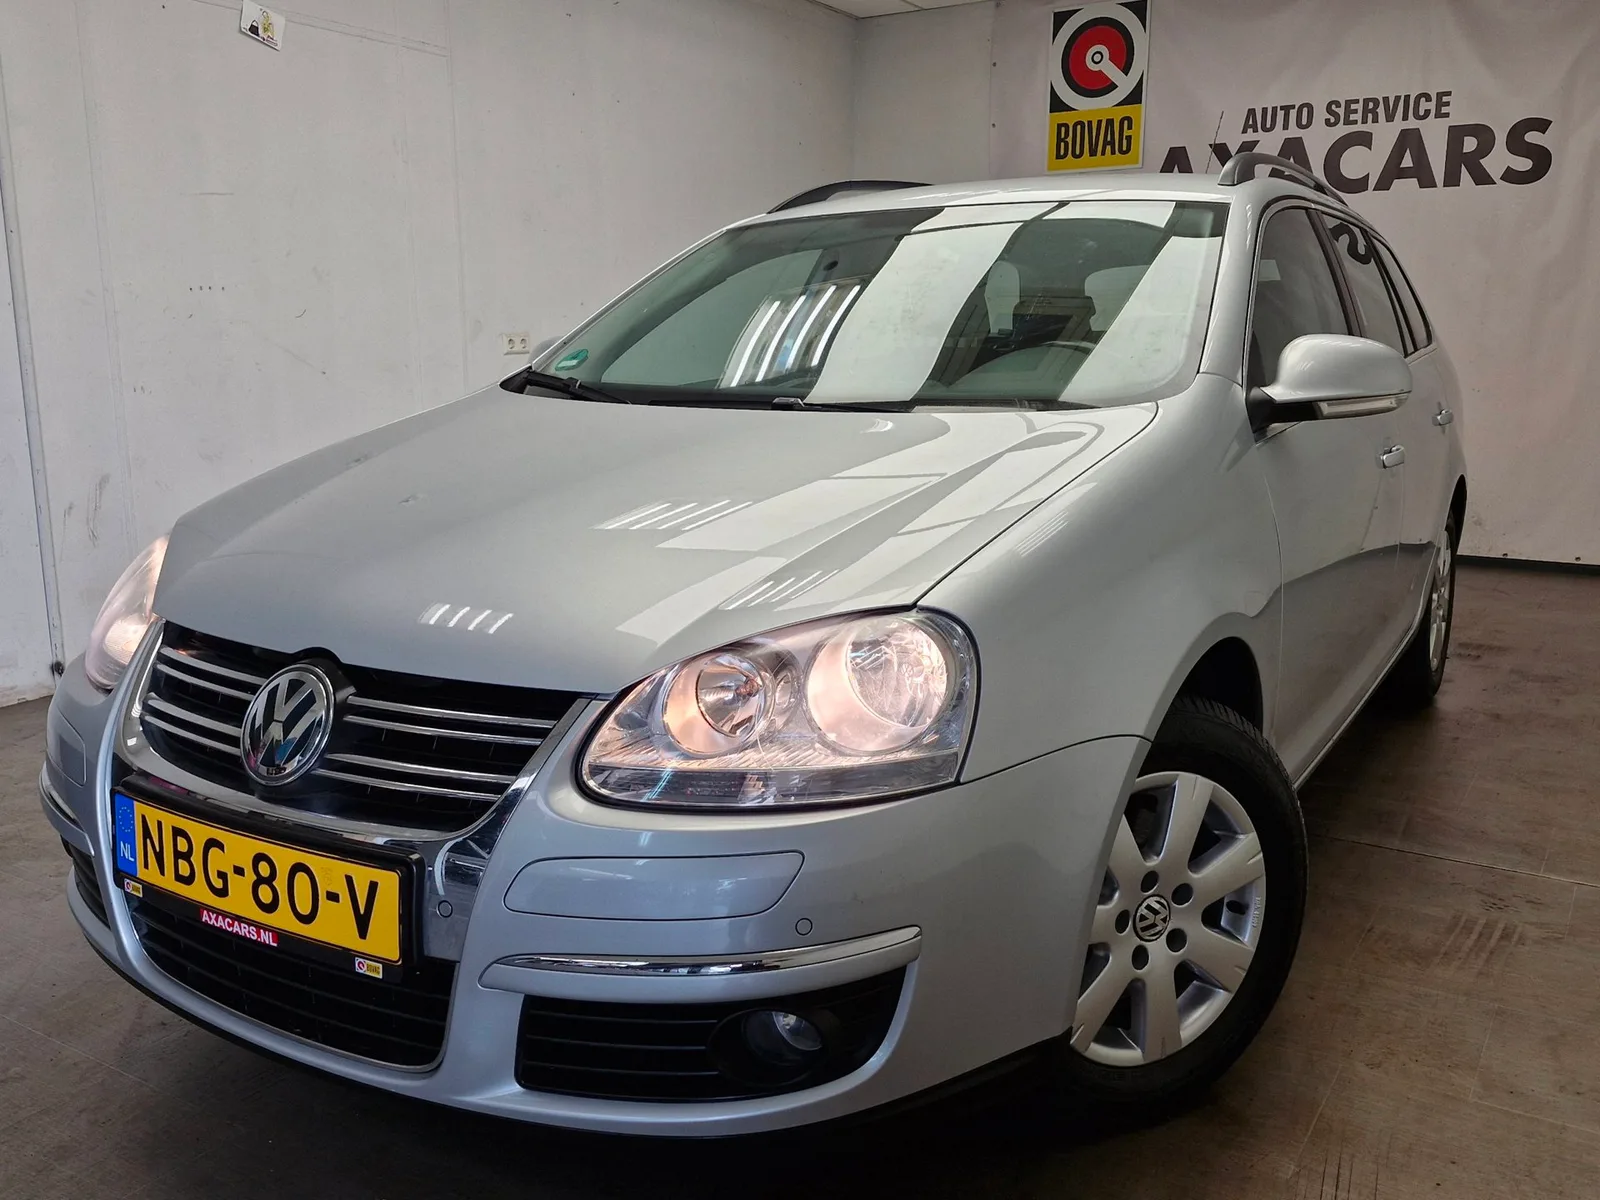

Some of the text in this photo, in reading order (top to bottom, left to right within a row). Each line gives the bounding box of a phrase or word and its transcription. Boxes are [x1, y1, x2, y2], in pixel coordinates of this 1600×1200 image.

[1241, 90, 1452, 134] AUTO SERVICE
[1055, 115, 1134, 161] BOVAG
[120, 841, 135, 862] NL
[140, 813, 379, 940] NBG-80-V
[202, 909, 278, 947] AXACARS.NL
